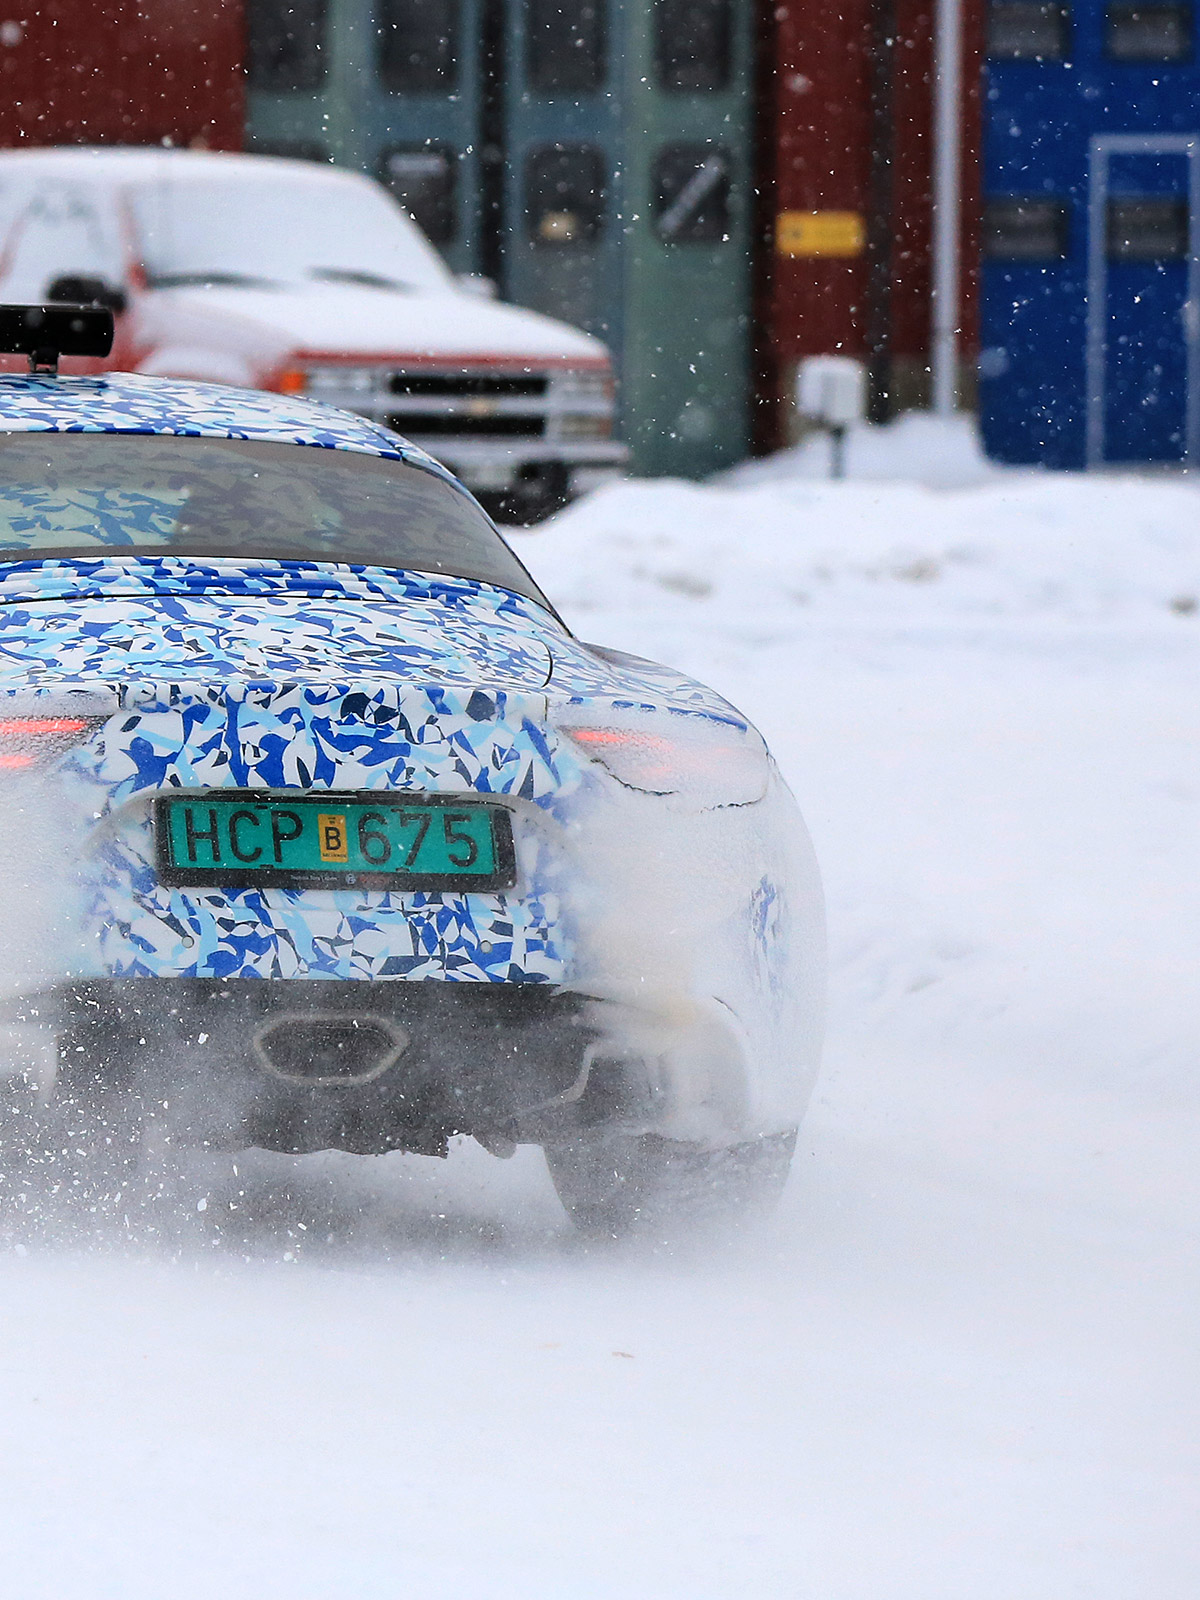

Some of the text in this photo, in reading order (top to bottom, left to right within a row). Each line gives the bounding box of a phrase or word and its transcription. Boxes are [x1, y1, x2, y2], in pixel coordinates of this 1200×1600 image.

[185, 808, 478, 867] HCP B 675
